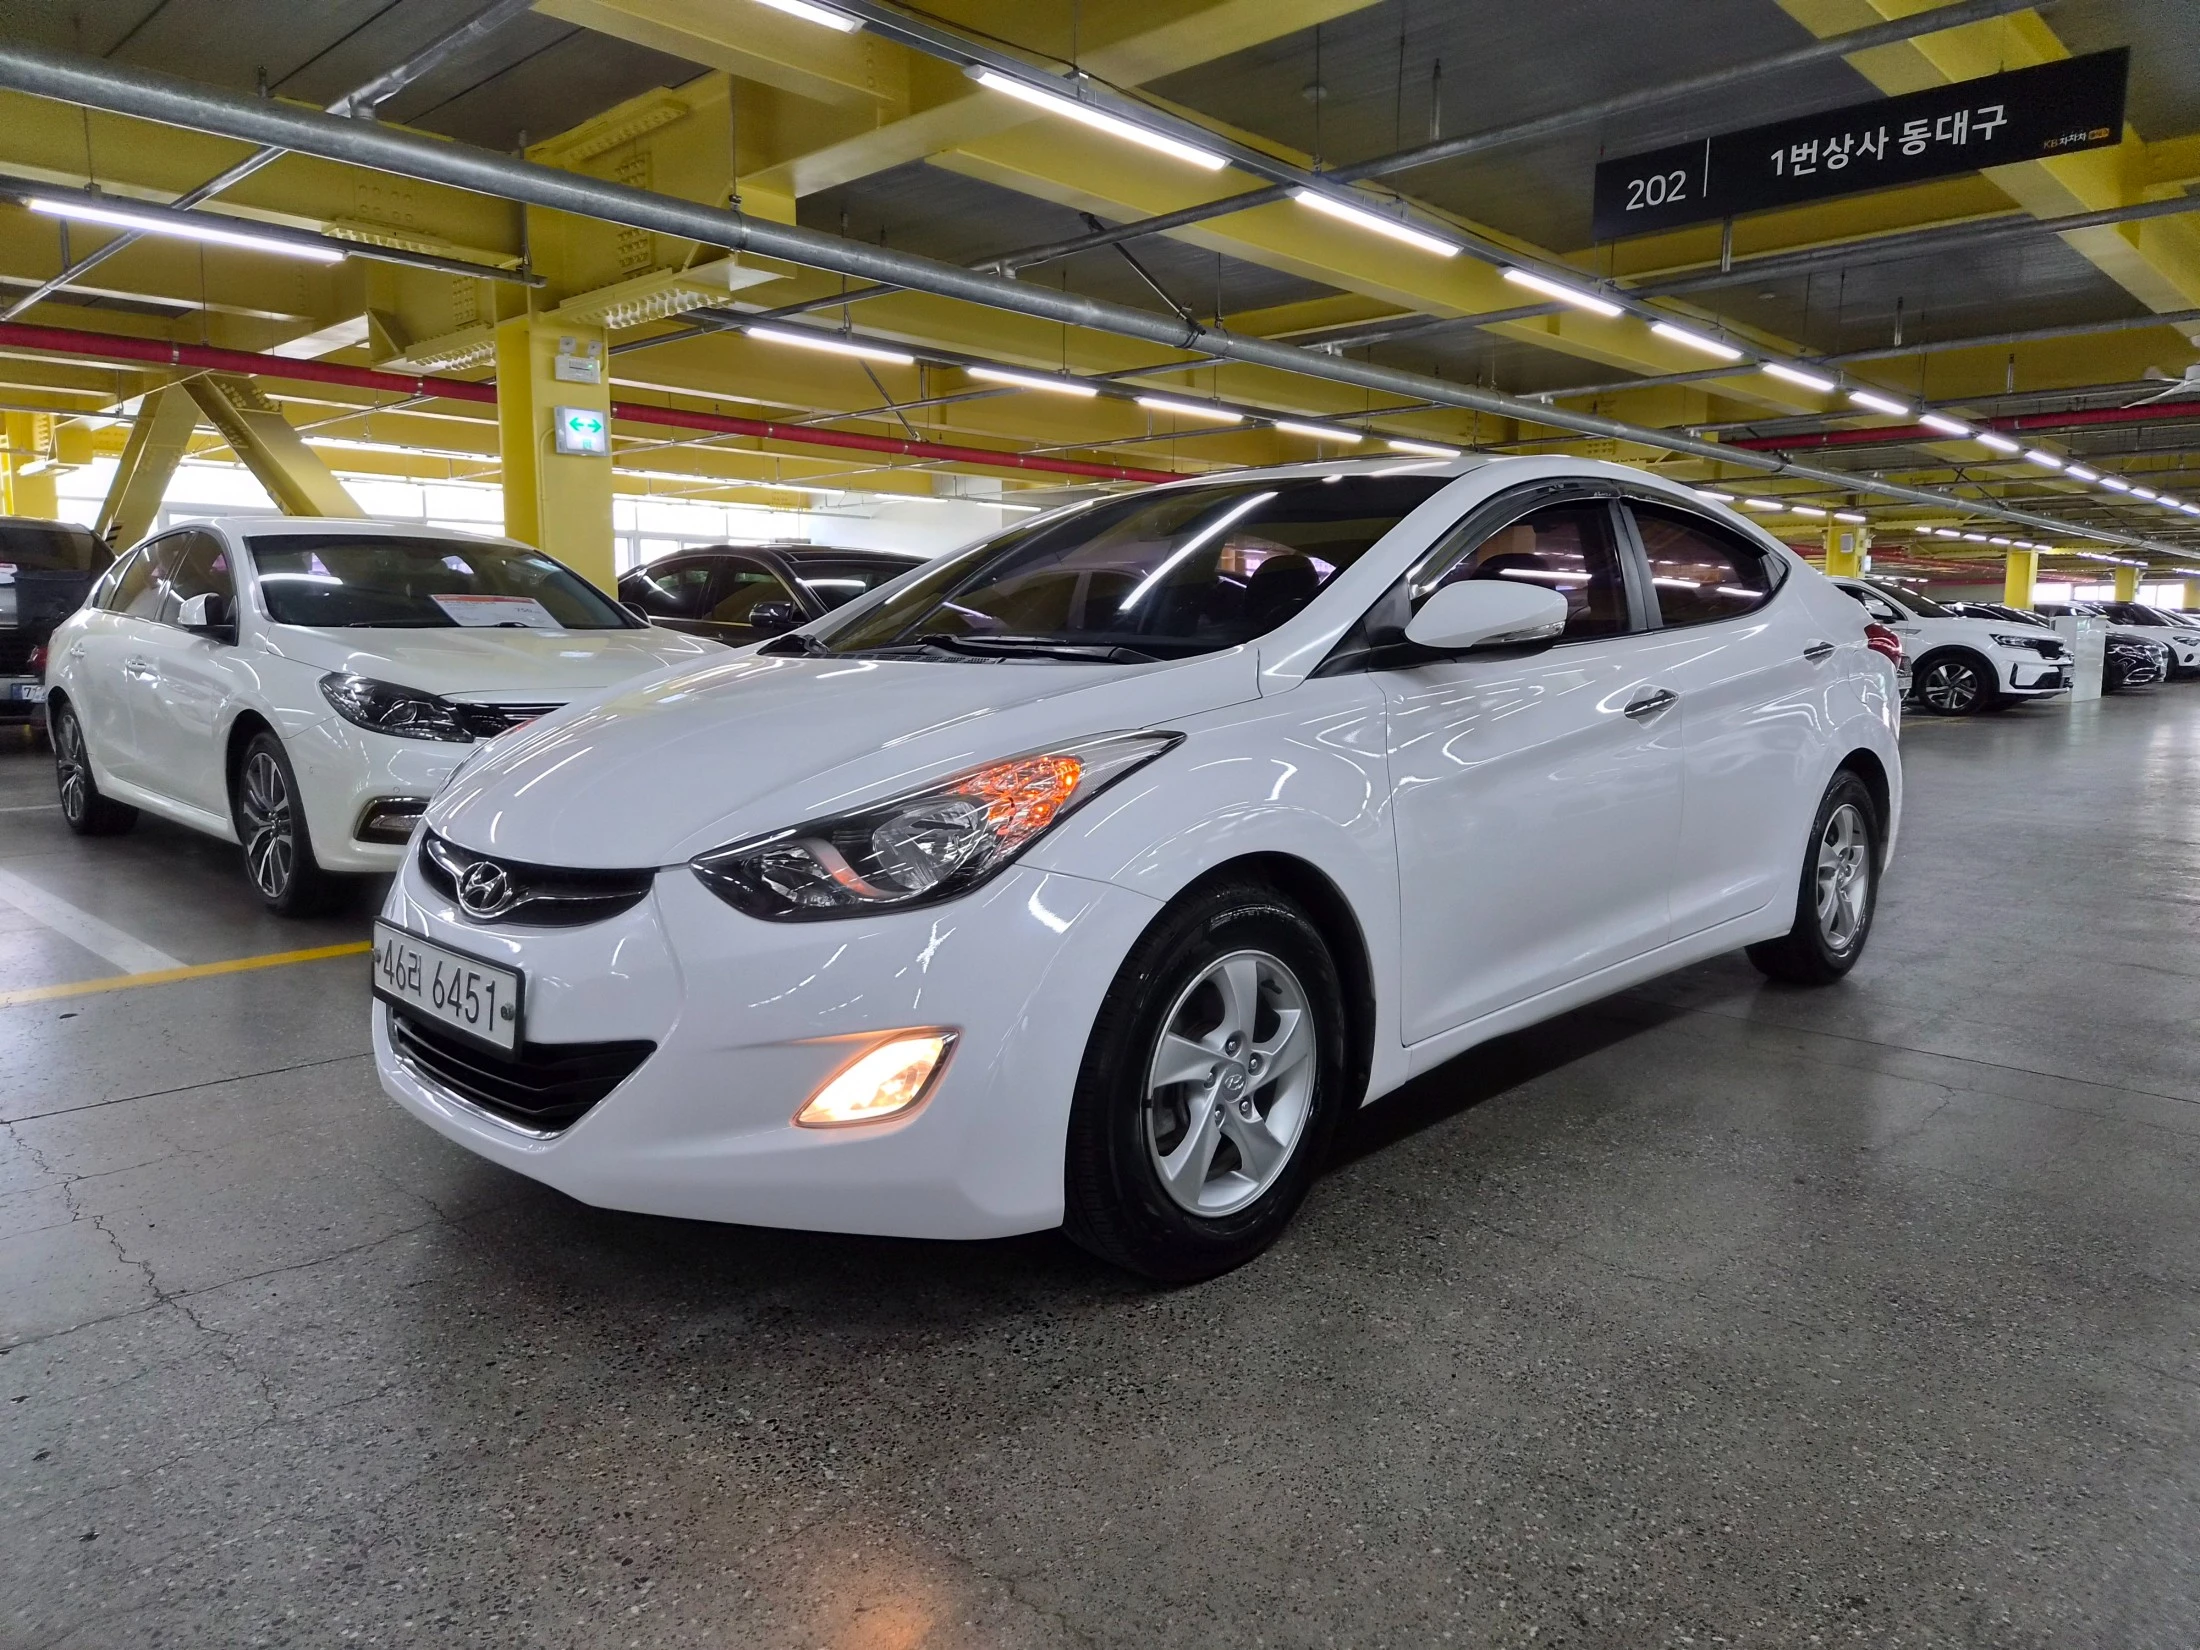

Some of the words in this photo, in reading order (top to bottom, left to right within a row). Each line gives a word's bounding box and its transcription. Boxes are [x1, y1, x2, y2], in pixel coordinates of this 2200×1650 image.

[1625, 170, 1687, 211] 202
[1770, 126, 1889, 177] 1번상사
[1898, 104, 2008, 156] 동대구
[432, 960, 496, 1032] 6451
